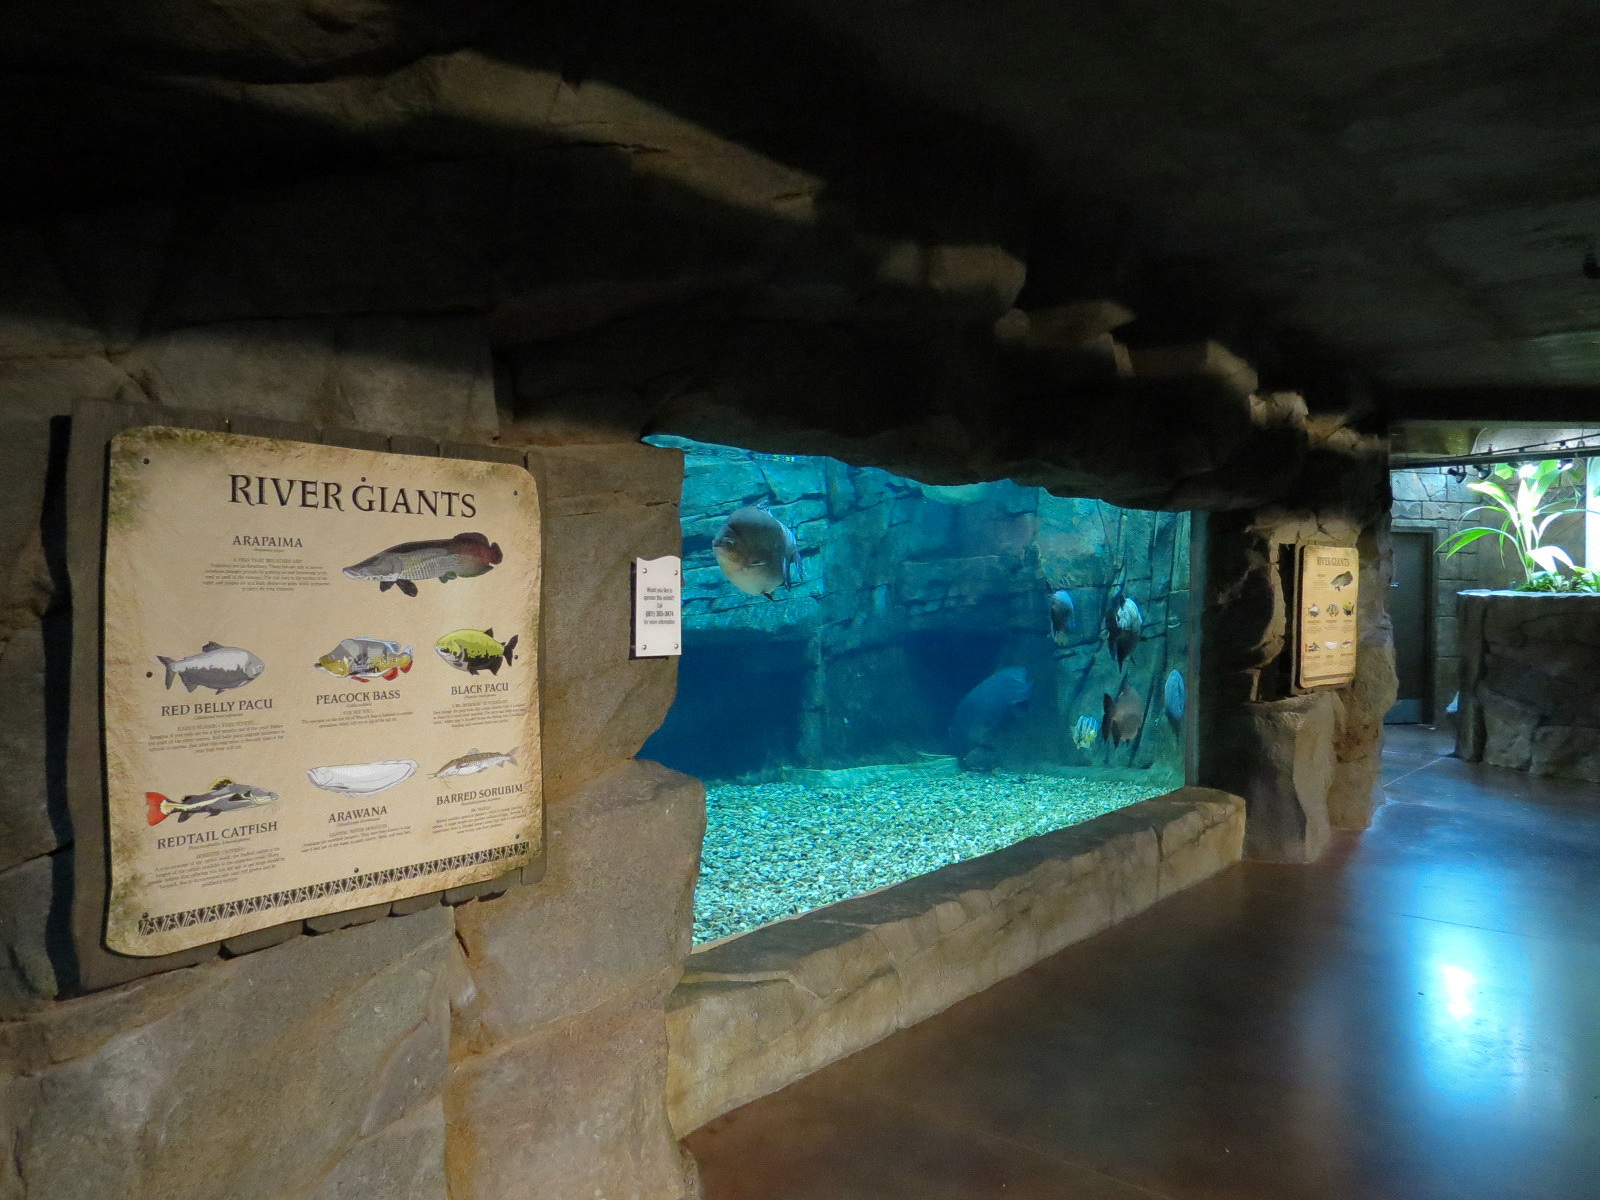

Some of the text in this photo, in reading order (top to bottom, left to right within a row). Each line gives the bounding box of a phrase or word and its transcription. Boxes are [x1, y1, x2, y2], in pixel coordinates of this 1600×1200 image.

[227, 474, 477, 518] RIVER GIANTS
[232, 535, 303, 548] ARAPAIMA
[316, 689, 401, 705] PEACOCK BASS
[451, 685, 482, 696] BLACK
[485, 682, 509, 692] PACU
[161, 704, 190, 717] RED
[194, 701, 235, 714] BELLY
[239, 698, 273, 711] PACU
[436, 790, 477, 805] BARRED
[478, 784, 523, 798] SORUBIM
[328, 805, 388, 823] ARAWANA
[157, 830, 219, 849] REDTAIL
[221, 821, 278, 839] CATFISH
